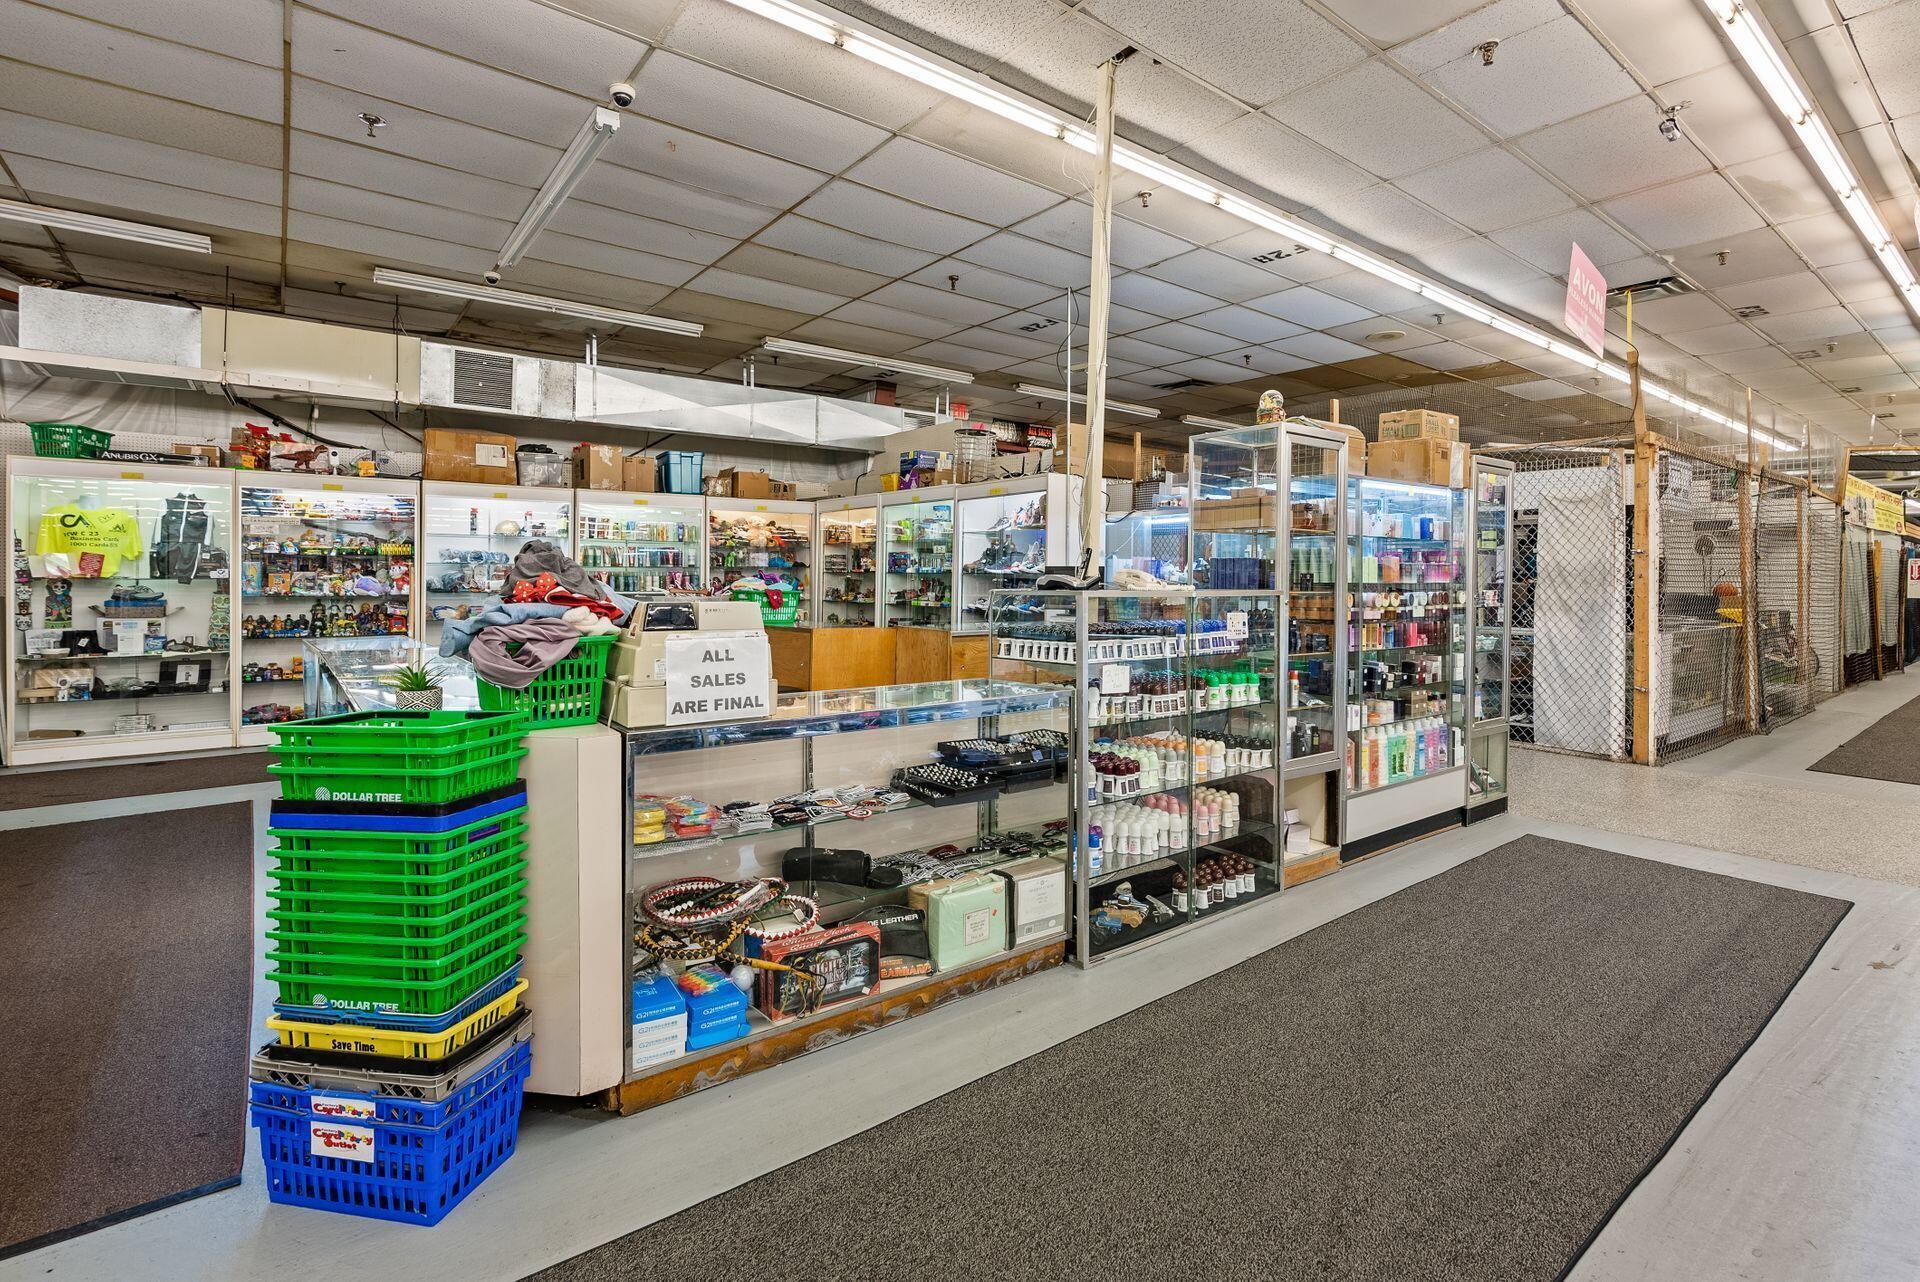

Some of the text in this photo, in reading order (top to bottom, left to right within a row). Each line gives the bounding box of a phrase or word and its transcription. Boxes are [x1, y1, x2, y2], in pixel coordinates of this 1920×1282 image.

[1573, 266, 1605, 315] AVON
[701, 649, 735, 663] ALL
[690, 672, 746, 689] SALES
[671, 695, 764, 715] ARE FINAL
[332, 791, 402, 802] DOLLAR TREE
[880, 913, 919, 925] LEATHER
[330, 999, 371, 1011] DOLLAR
[331, 1038, 352, 1051] Save
[313, 1102, 343, 1115] Card
[345, 1104, 375, 1117] Party
[312, 1128, 342, 1140] Card
[344, 1130, 373, 1146] Party
[324, 1137, 357, 1150] Outlet
